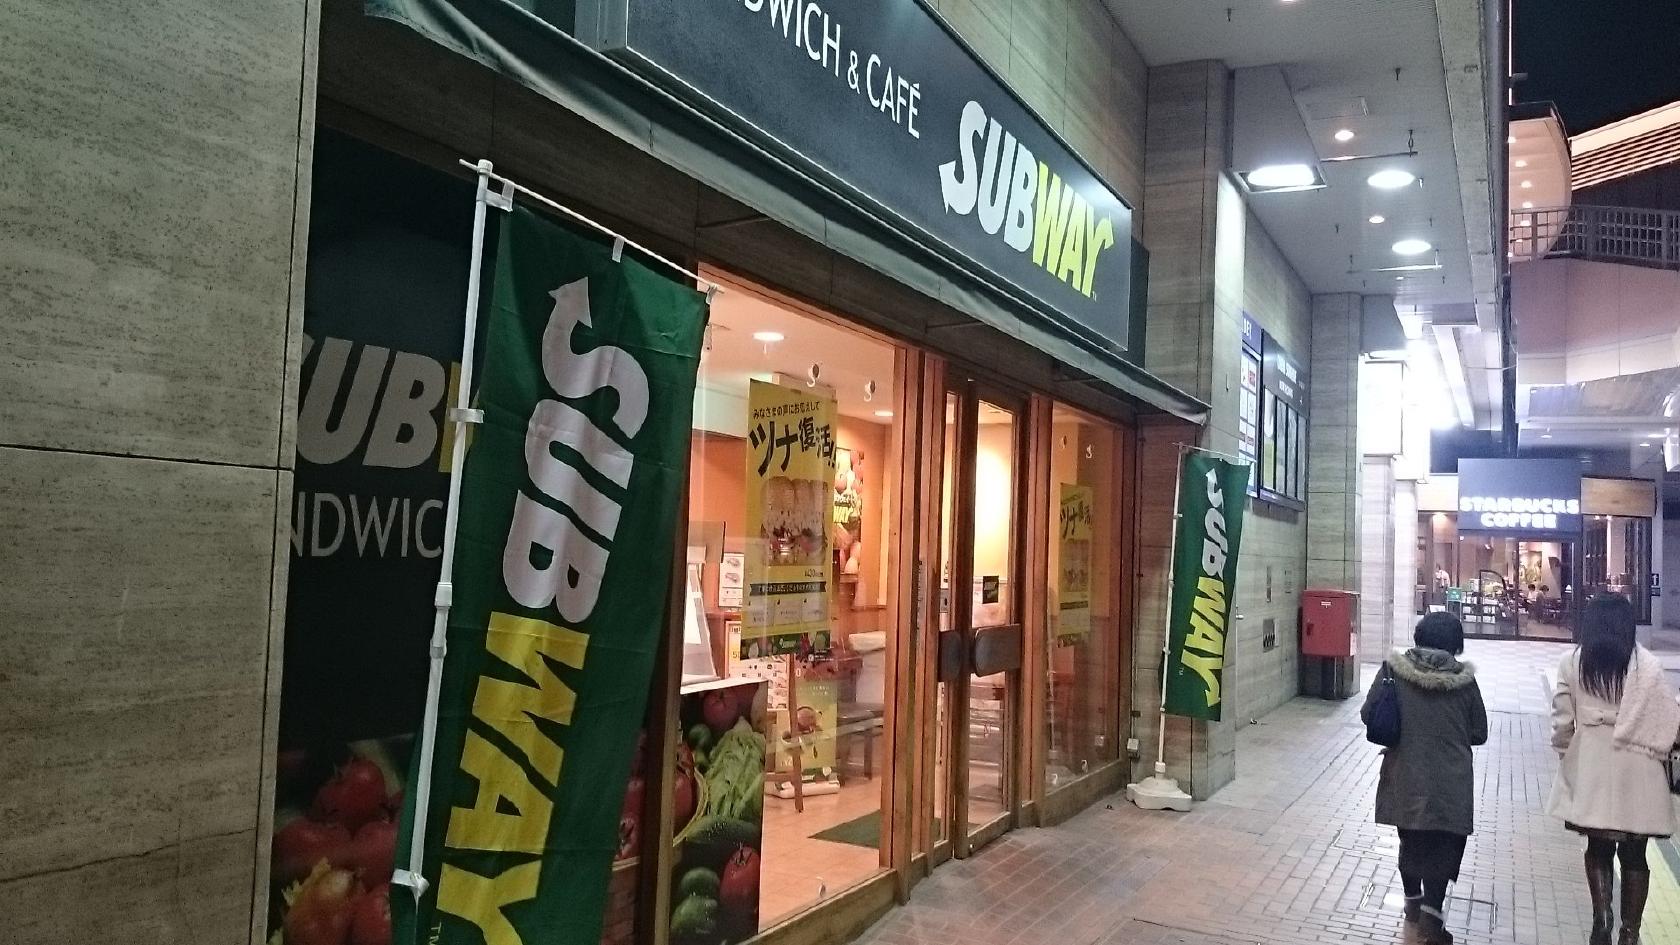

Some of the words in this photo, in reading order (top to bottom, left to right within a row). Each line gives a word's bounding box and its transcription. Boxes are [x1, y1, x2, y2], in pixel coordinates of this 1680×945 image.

[847, 50, 860, 95] &
[866, 53, 921, 139] CAFÉ
[938, 100, 1114, 298] SUBWAY
[1459, 497, 1579, 514] STARBUCKS
[1481, 513, 1557, 528] COFFEE
[435, 276, 650, 945] SUBWAY
[1180, 467, 1229, 707] SUBWAY
